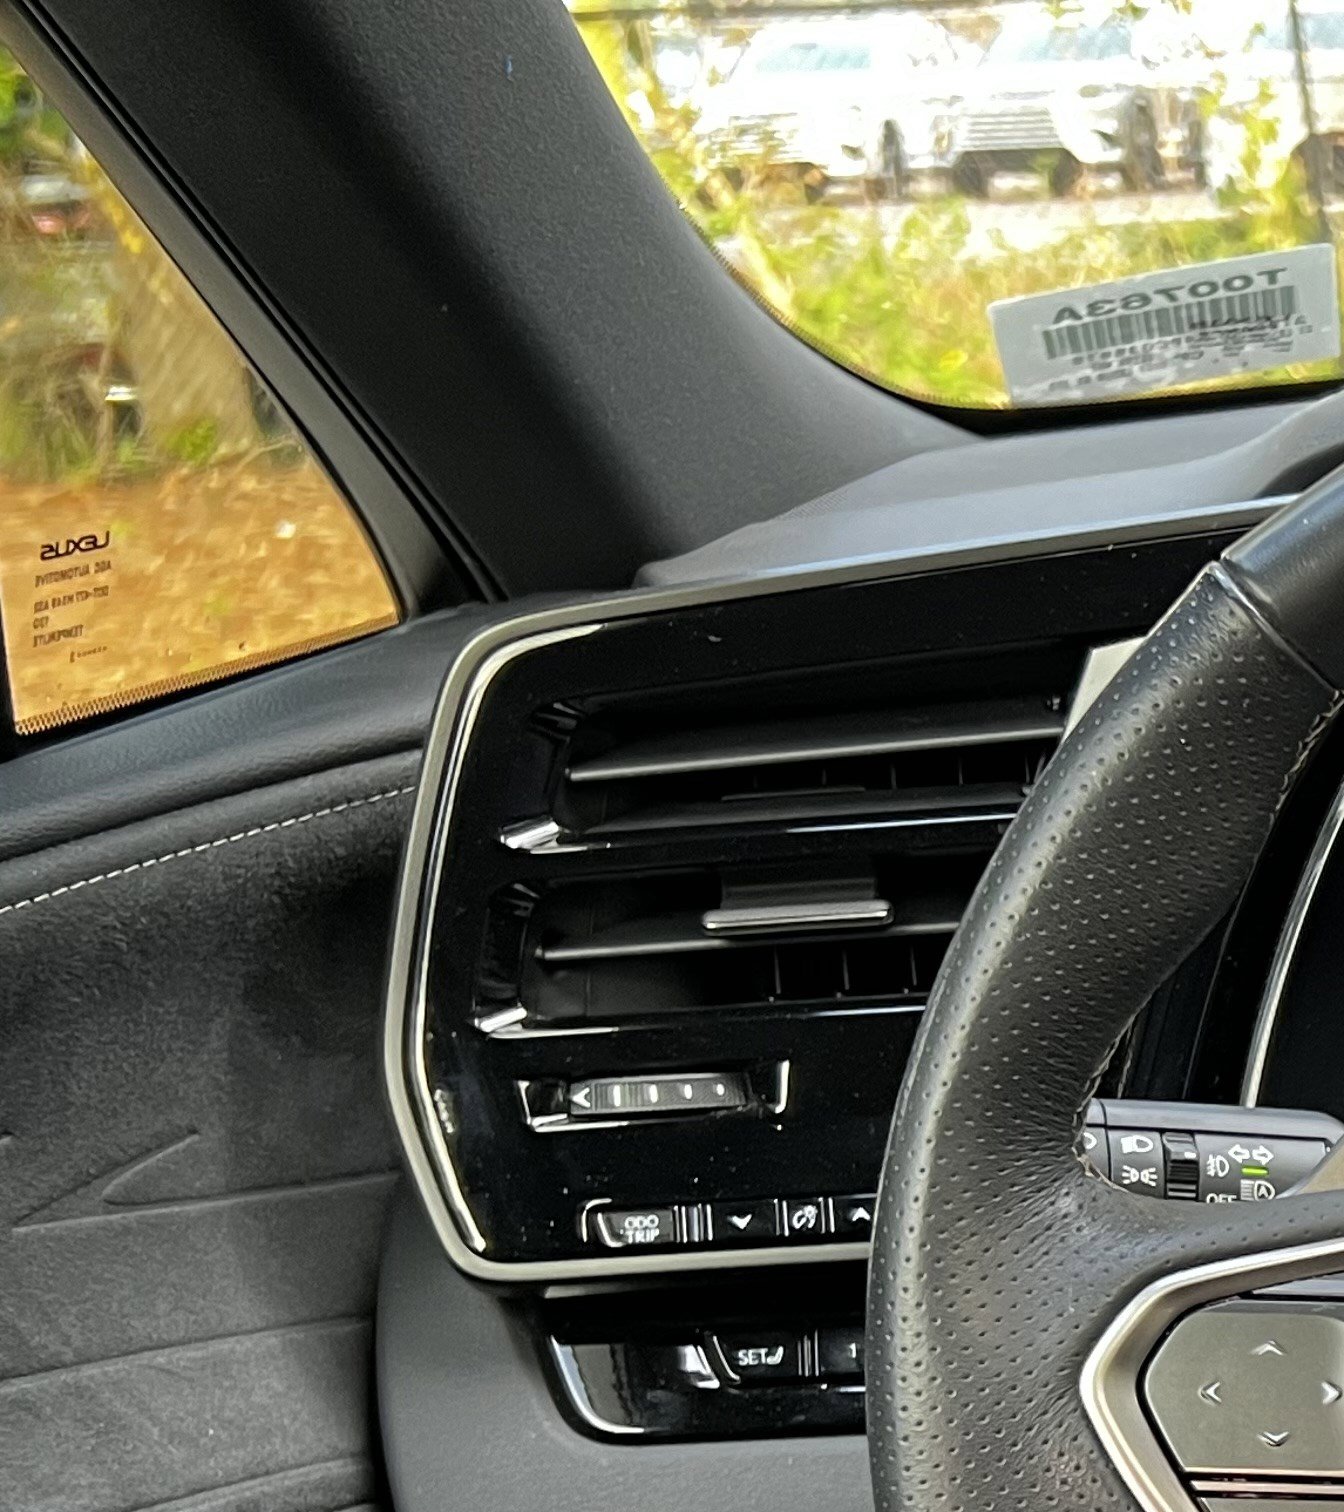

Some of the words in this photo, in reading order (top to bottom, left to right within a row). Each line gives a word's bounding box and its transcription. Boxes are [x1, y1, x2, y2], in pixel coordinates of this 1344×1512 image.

[624, 1214, 660, 1229] ODO
[625, 1228, 660, 1244] TRIP
[738, 1348, 768, 1366] SET
[848, 1342, 857, 1358] 1
